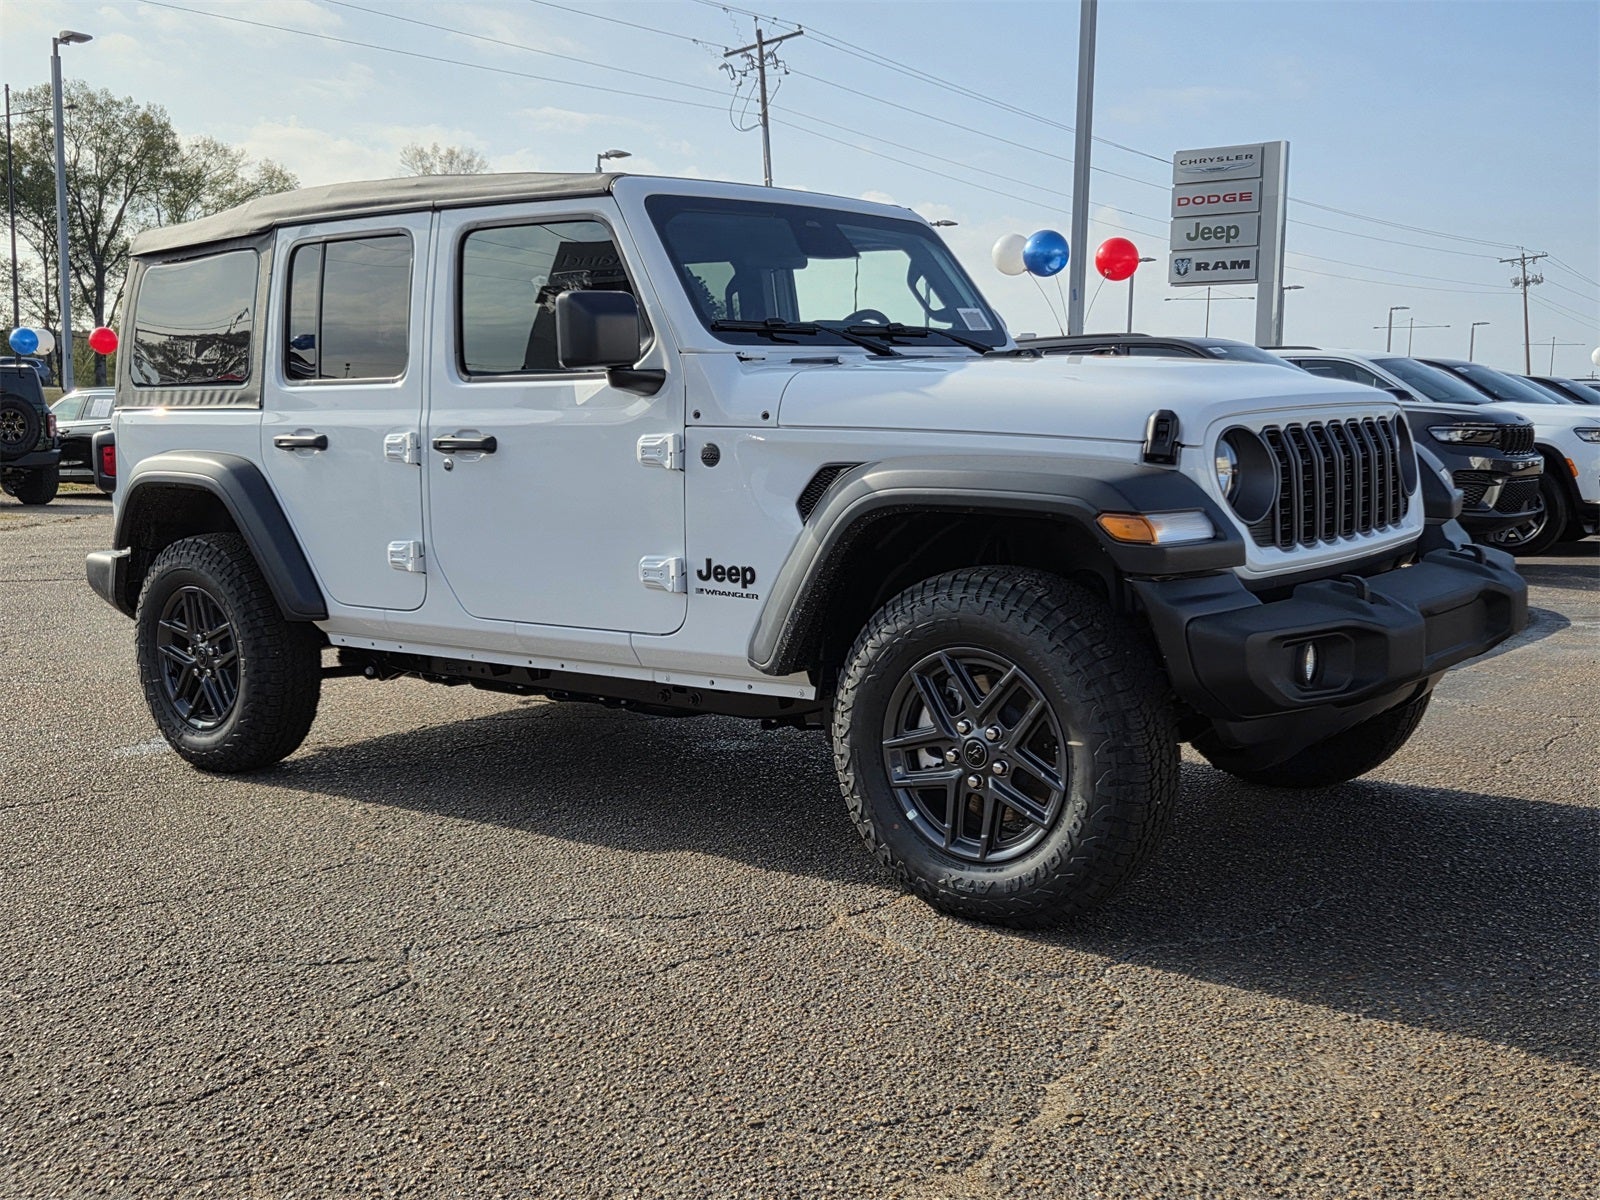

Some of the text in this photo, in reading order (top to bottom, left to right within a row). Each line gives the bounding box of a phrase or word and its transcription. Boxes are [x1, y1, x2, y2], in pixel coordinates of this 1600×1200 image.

[1179, 153, 1254, 166] CHRYSLER
[1177, 191, 1253, 207] DODGE
[1185, 222, 1240, 243] Jeep
[1195, 259, 1251, 271] RAM
[696, 557, 756, 589] Jeep
[704, 588, 759, 600] WRANGLER
[937, 873, 996, 895] ATX
